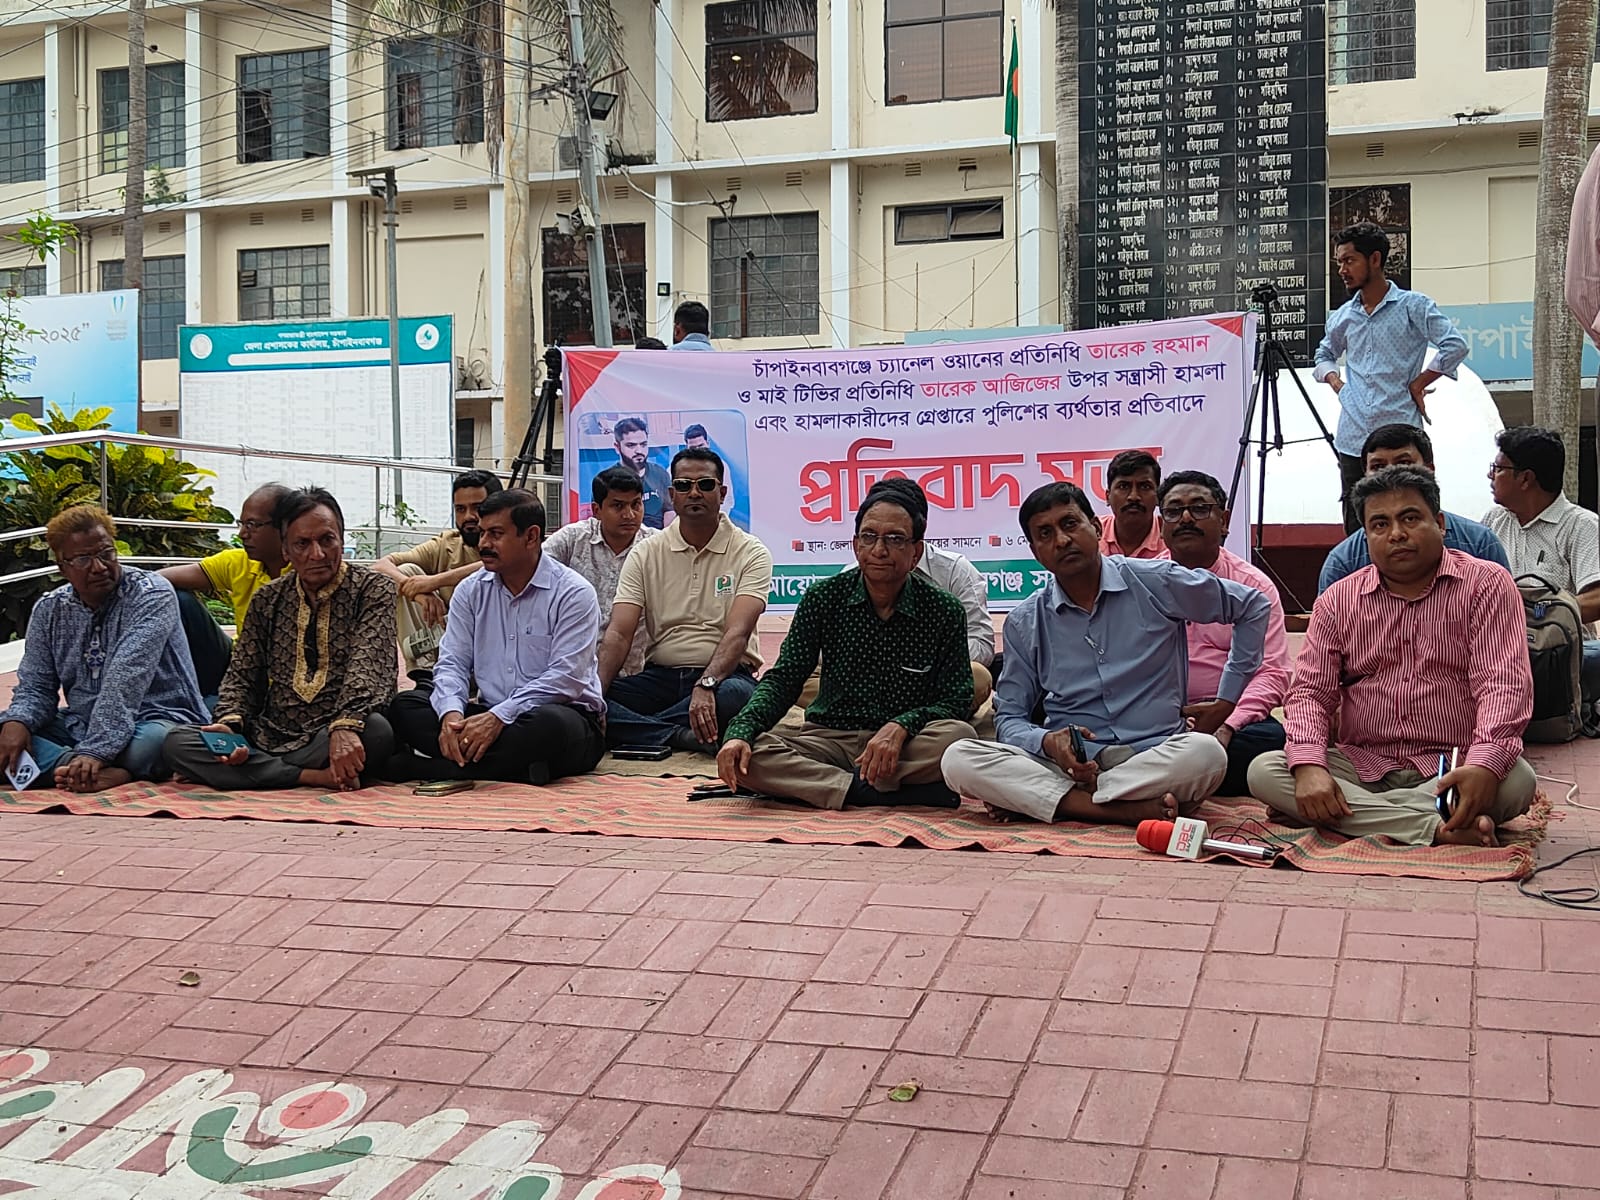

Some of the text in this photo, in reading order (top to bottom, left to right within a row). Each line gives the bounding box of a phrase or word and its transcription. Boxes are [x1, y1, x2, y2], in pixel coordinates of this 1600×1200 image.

[1277, 275, 1306, 288] নাচোল
[1271, 309, 1306, 325] ভোলাহাট
[752, 335, 1211, 379] চাঁপাইনবাবগঞ্জে চ্যানেল ওয়ানের প্রতিনিধি তারেক রহমান
[737, 361, 1227, 405] ও মাই টিভির প্রতিনিধি তারেক আজিজের উপর সন্ত্রাসী হামলা
[754, 392, 1207, 433] এবং হামলাকারীদের গ্রেপ্তারে পুলিশের ব্যর্থতার প্রতিবাদে
[952, 537, 982, 548] সামনে
[1005, 536, 1013, 545] ৬
